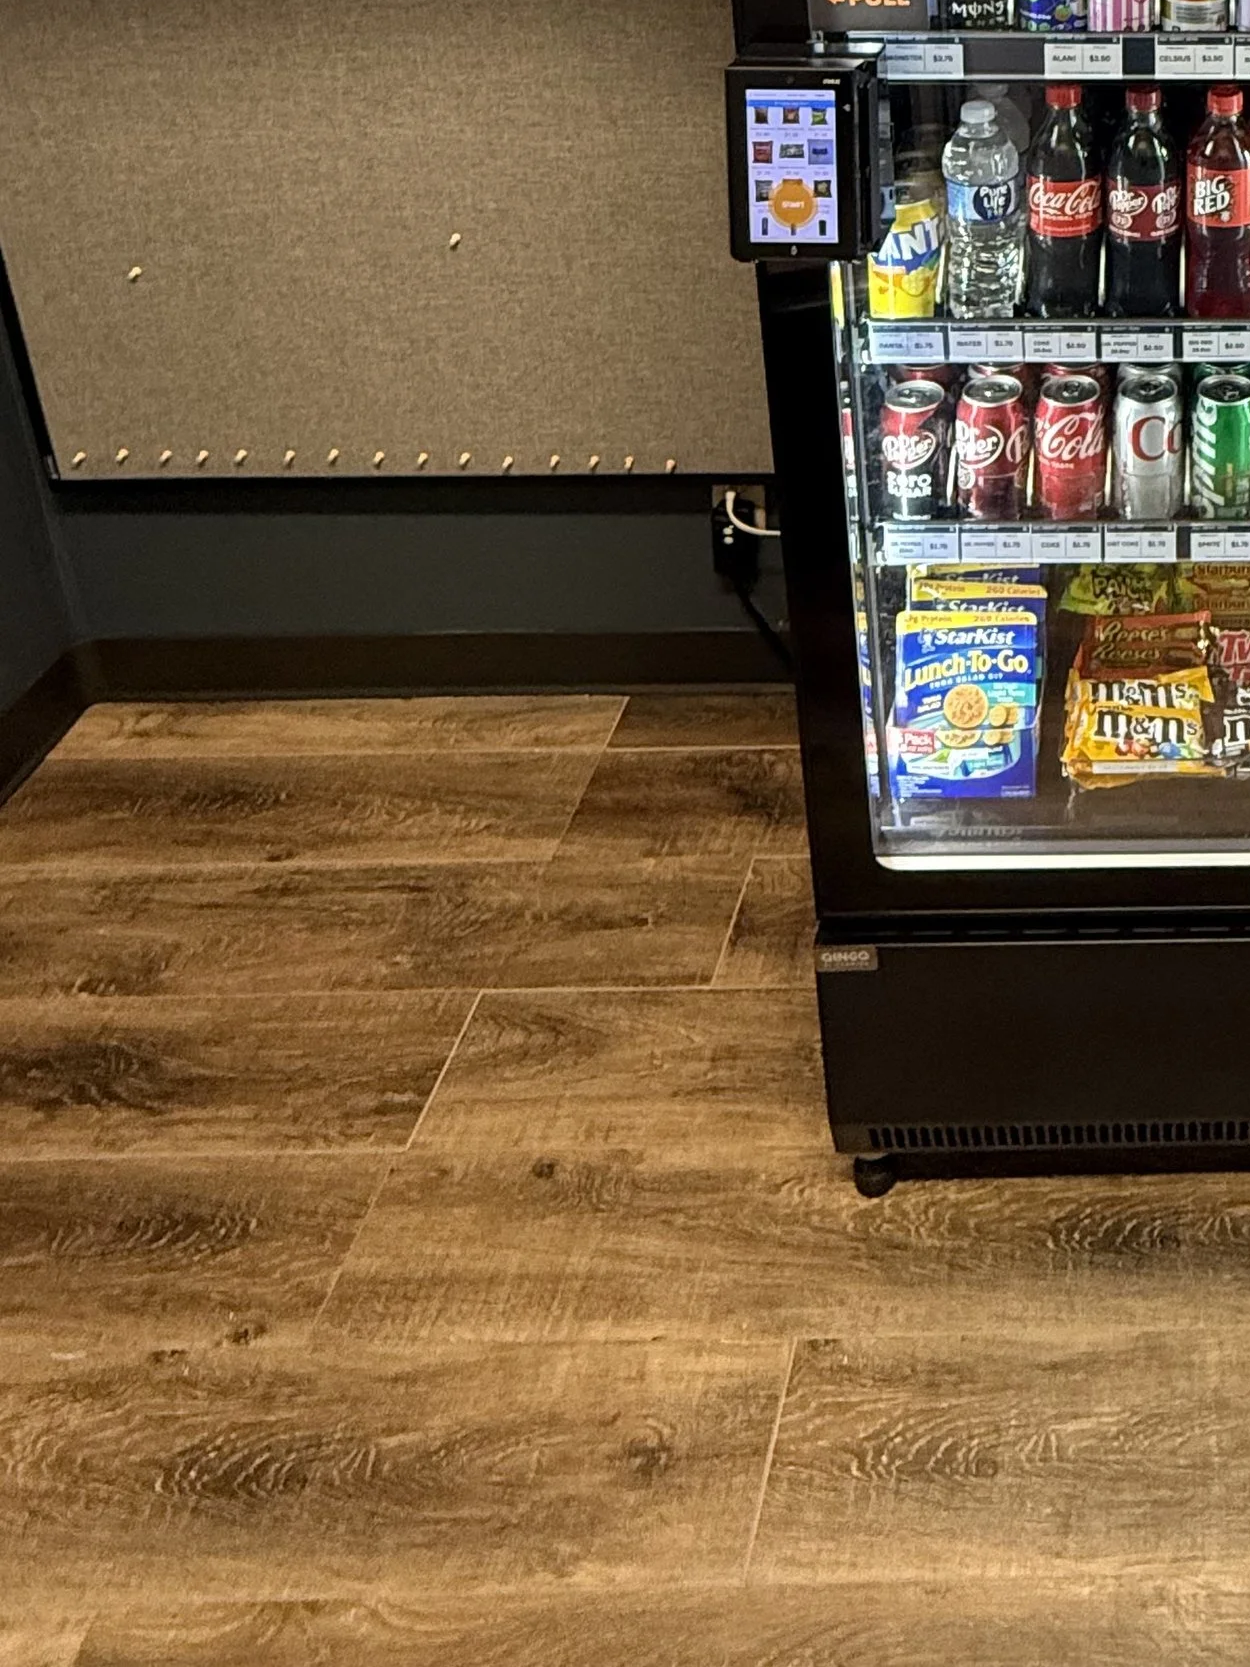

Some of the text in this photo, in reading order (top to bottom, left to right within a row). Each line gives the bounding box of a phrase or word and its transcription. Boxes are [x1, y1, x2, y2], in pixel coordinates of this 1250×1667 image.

[1159, 55, 1191, 63] CELSIUS
[979, 184, 1009, 199] Pure
[1194, 175, 1226, 197] BIG
[982, 194, 1007, 210] Life
[1192, 192, 1231, 217] RED
[934, 627, 1016, 646] StarKist
